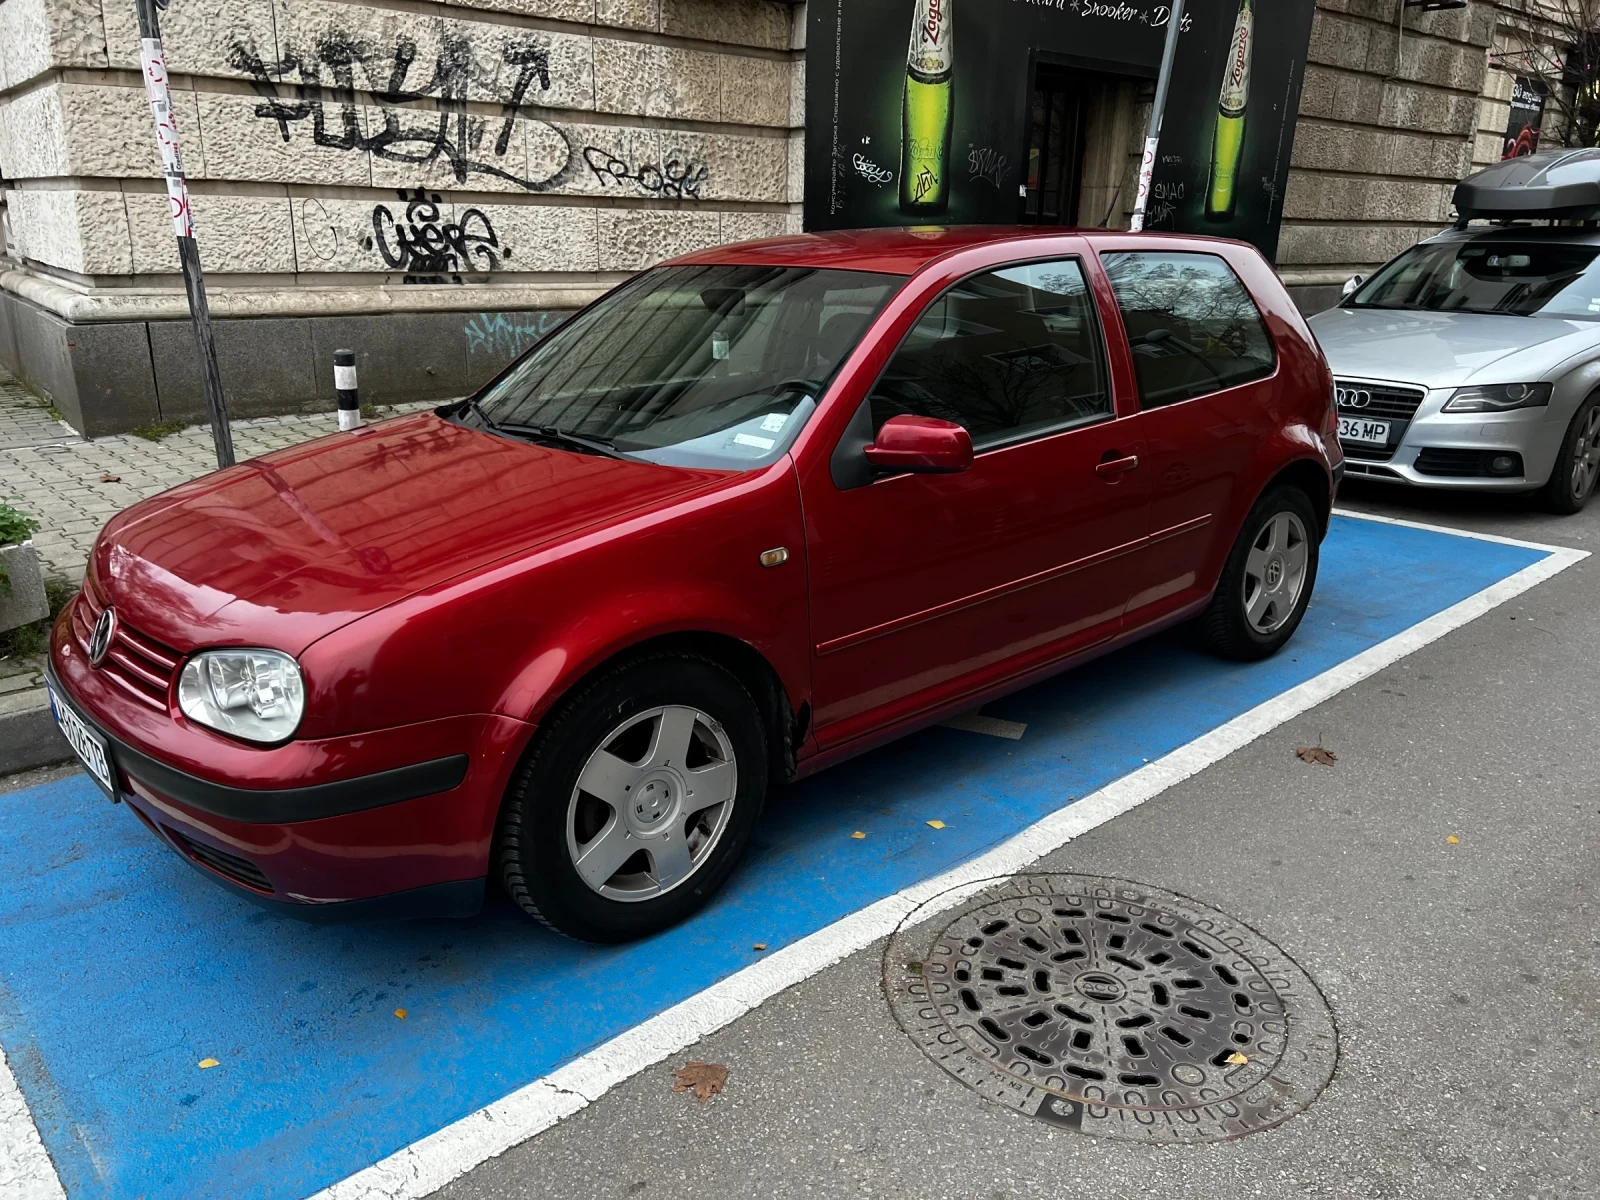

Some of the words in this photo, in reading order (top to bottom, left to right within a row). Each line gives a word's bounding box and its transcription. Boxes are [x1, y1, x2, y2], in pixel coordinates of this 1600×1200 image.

[1081, 0, 1138, 21] Snooker
[1150, 5, 1193, 33] Dts
[1232, 26, 1249, 89] Zagorka
[1337, 419, 1359, 437] 36
[1361, 422, 1386, 440] MP
[1082, 982, 1121, 994] ACO
[1008, 1080, 1023, 1091] EN
